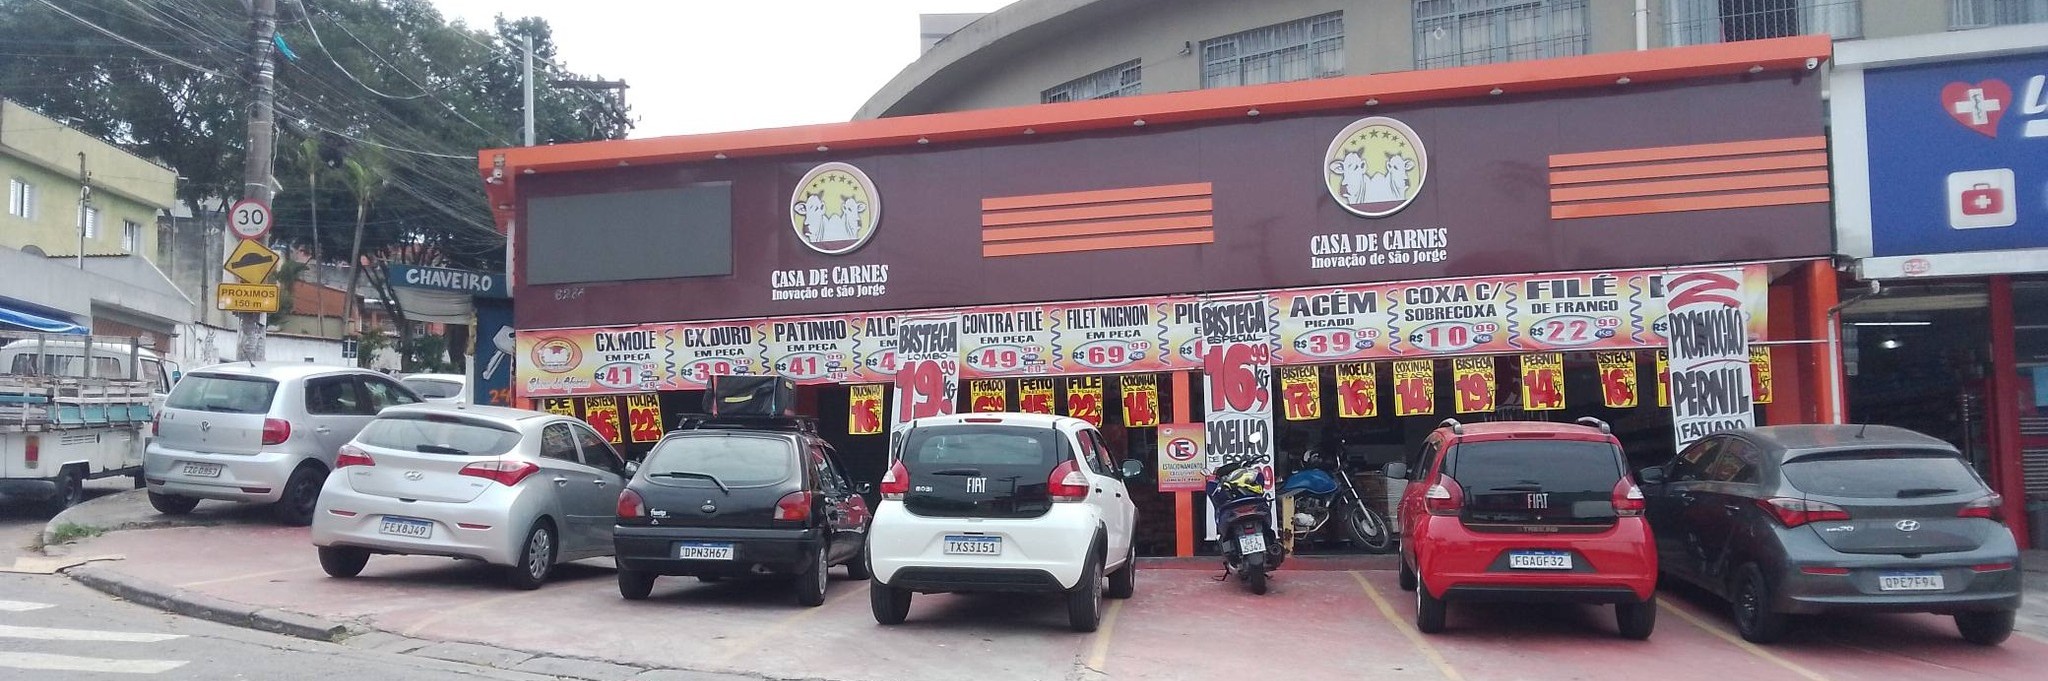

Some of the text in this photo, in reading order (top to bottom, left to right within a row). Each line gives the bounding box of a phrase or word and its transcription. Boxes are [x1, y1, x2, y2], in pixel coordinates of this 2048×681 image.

[238, 209, 263, 225] 30
[1311, 228, 1447, 255] CASA DE CARNES
[1312, 249, 1447, 269] Inovação de São Jorge
[1904, 261, 1930, 271] 625
[406, 268, 493, 291] CHAVEIRO
[772, 264, 889, 288] CASA DE CARNES
[772, 283, 885, 300] Inovação de São Jorge
[1405, 283, 1502, 304] COXA C/
[1527, 274, 1617, 300] FILÉ
[234, 300, 250, 308] 150
[1290, 289, 1376, 317] ACÉM
[1532, 300, 1618, 314] DE FRANGO
[962, 308, 1043, 334] CONTRA FILÉ
[1067, 305, 1148, 330] FILET MIGNON
[1202, 301, 1267, 336] BISTECA
[1405, 304, 1496, 321] SOBRECOXA
[774, 319, 846, 342] PATINHO
[866, 316, 898, 337] ALC
[1305, 318, 1354, 328] PICADO
[1530, 328, 1543, 336] R$
[1547, 320, 1587, 341] 22
[1598, 318, 1617, 327] 99
[1653, 322, 1667, 331] R$
[595, 331, 656, 352] CX.MOLE
[684, 326, 752, 347] CX.DURO
[899, 321, 957, 353] BISTECA
[981, 335, 1034, 344] EM PEÇA
[1086, 330, 1141, 340] EM PEÇA
[1207, 334, 1263, 344] ESPECIAL
[1294, 330, 1376, 353] R$ 39 99
[1410, 334, 1423, 342] R$
[1427, 325, 1467, 347] 10
[1475, 324, 1496, 333] 99
[715, 348, 744, 356] PEÇA
[808, 343, 837, 351] PEÇA
[1073, 351, 1084, 360] R$
[1089, 346, 1124, 364] 69
[1130, 342, 1148, 350] 99
[624, 353, 650, 361] PEÇA
[775, 363, 786, 371] R$
[789, 356, 816, 375] 41
[866, 352, 895, 370] R$ 4
[968, 355, 978, 364] R$
[982, 349, 1016, 368] 49
[1456, 357, 1492, 370] BISTECA
[1524, 354, 1560, 365] PERNIL
[606, 366, 632, 384] 41
[694, 361, 730, 380] 39
[941, 360, 955, 376] 99
[1281, 366, 1316, 379] BISTECA
[1338, 363, 1374, 376] MOELA
[1395, 361, 1431, 373] COXINHA
[972, 380, 1003, 392] FIGADO
[1020, 379, 1052, 391] PEITO
[1068, 376, 1101, 390] FILE
[1672, 367, 1749, 417] PERNIL
[587, 396, 615, 407] BISTECA
[629, 396, 658, 406] TULIPA
[1207, 419, 1269, 455] JOELHO
[967, 476, 987, 493] FIAT
[1527, 492, 1548, 509] FIAT
[383, 522, 427, 536] FEX8J49
[684, 547, 728, 558] DPN3H67
